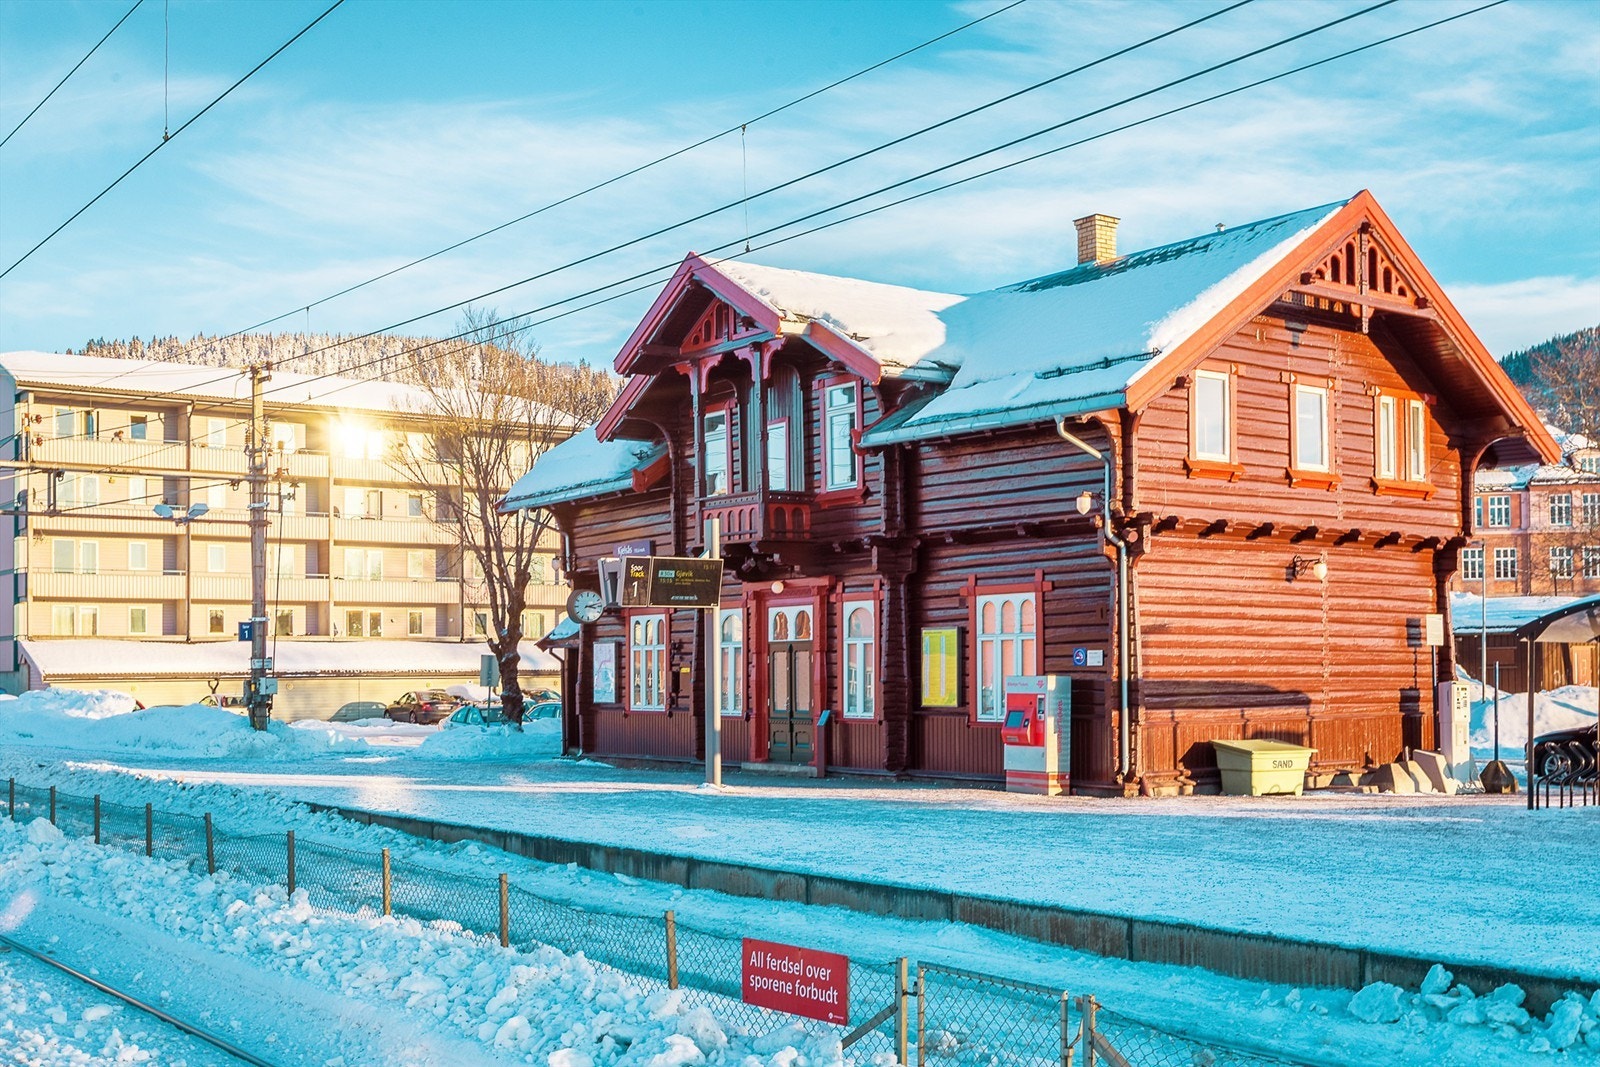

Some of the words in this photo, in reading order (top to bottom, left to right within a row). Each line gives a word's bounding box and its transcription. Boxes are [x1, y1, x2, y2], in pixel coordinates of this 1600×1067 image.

[630, 570, 645, 578] Track
[632, 581, 638, 597] 1
[244, 630, 248, 639] 1
[1272, 760, 1293, 769] SAND
[750, 951, 764, 968] All
[766, 953, 803, 976] ferdsel
[806, 964, 831, 981] over
[750, 974, 792, 995] sporene
[795, 980, 838, 1005] forbudt
